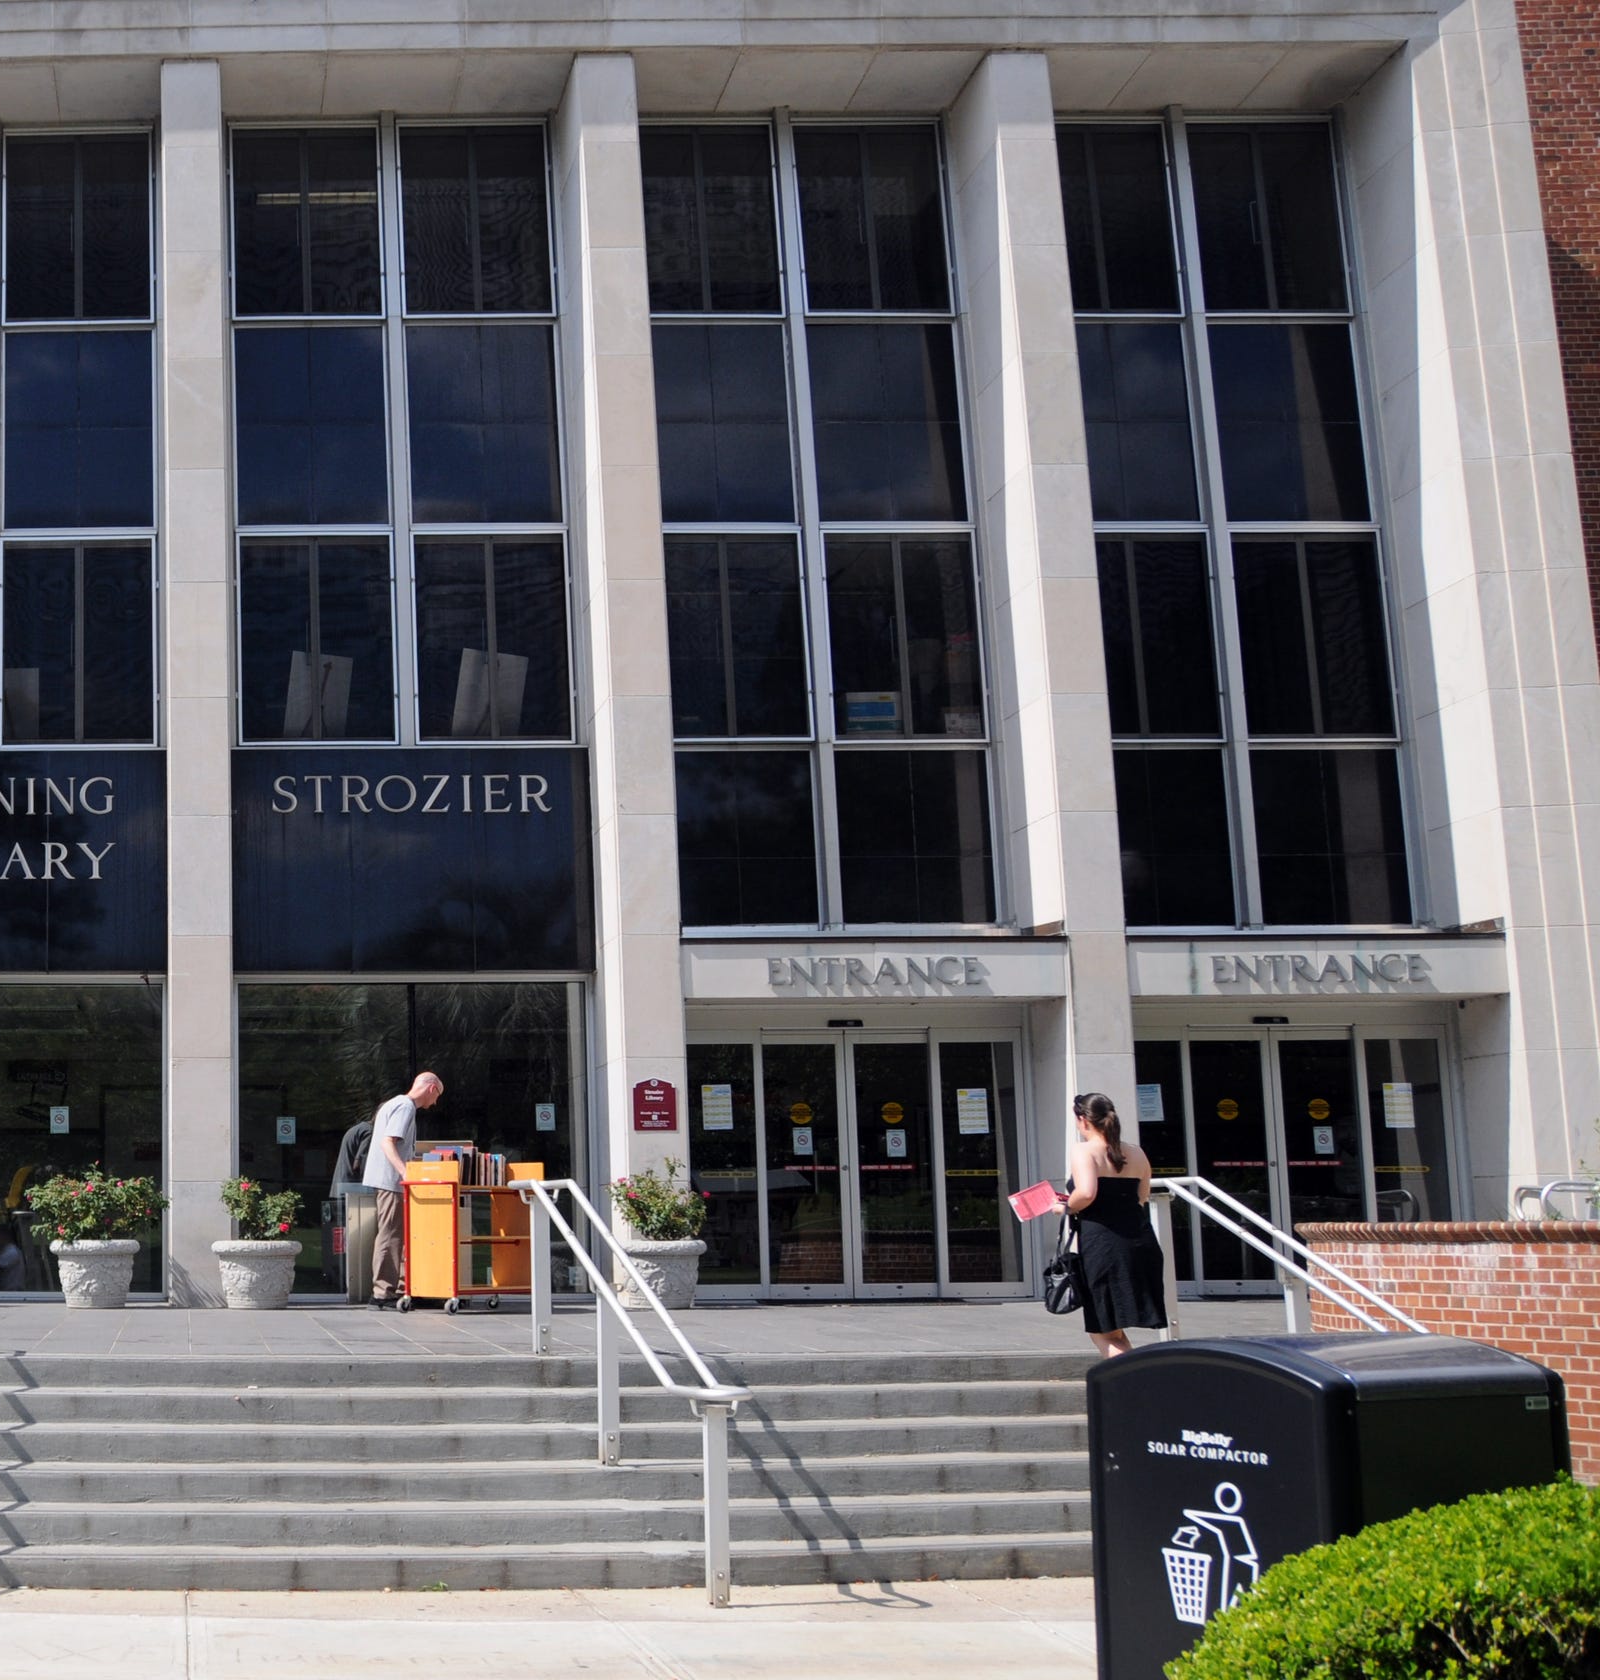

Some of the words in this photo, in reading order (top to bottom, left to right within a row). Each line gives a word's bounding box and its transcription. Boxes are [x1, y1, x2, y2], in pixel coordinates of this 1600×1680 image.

[272, 774, 552, 813] STROZIER
[766, 955, 984, 986] ENTRANCE
[1210, 953, 1427, 984] ENTRANCE
[1147, 1441, 1187, 1456] SOLAR
[1189, 1446, 1269, 1466] COMPACTOR
[1181, 1429, 1233, 1448] BigBelly
